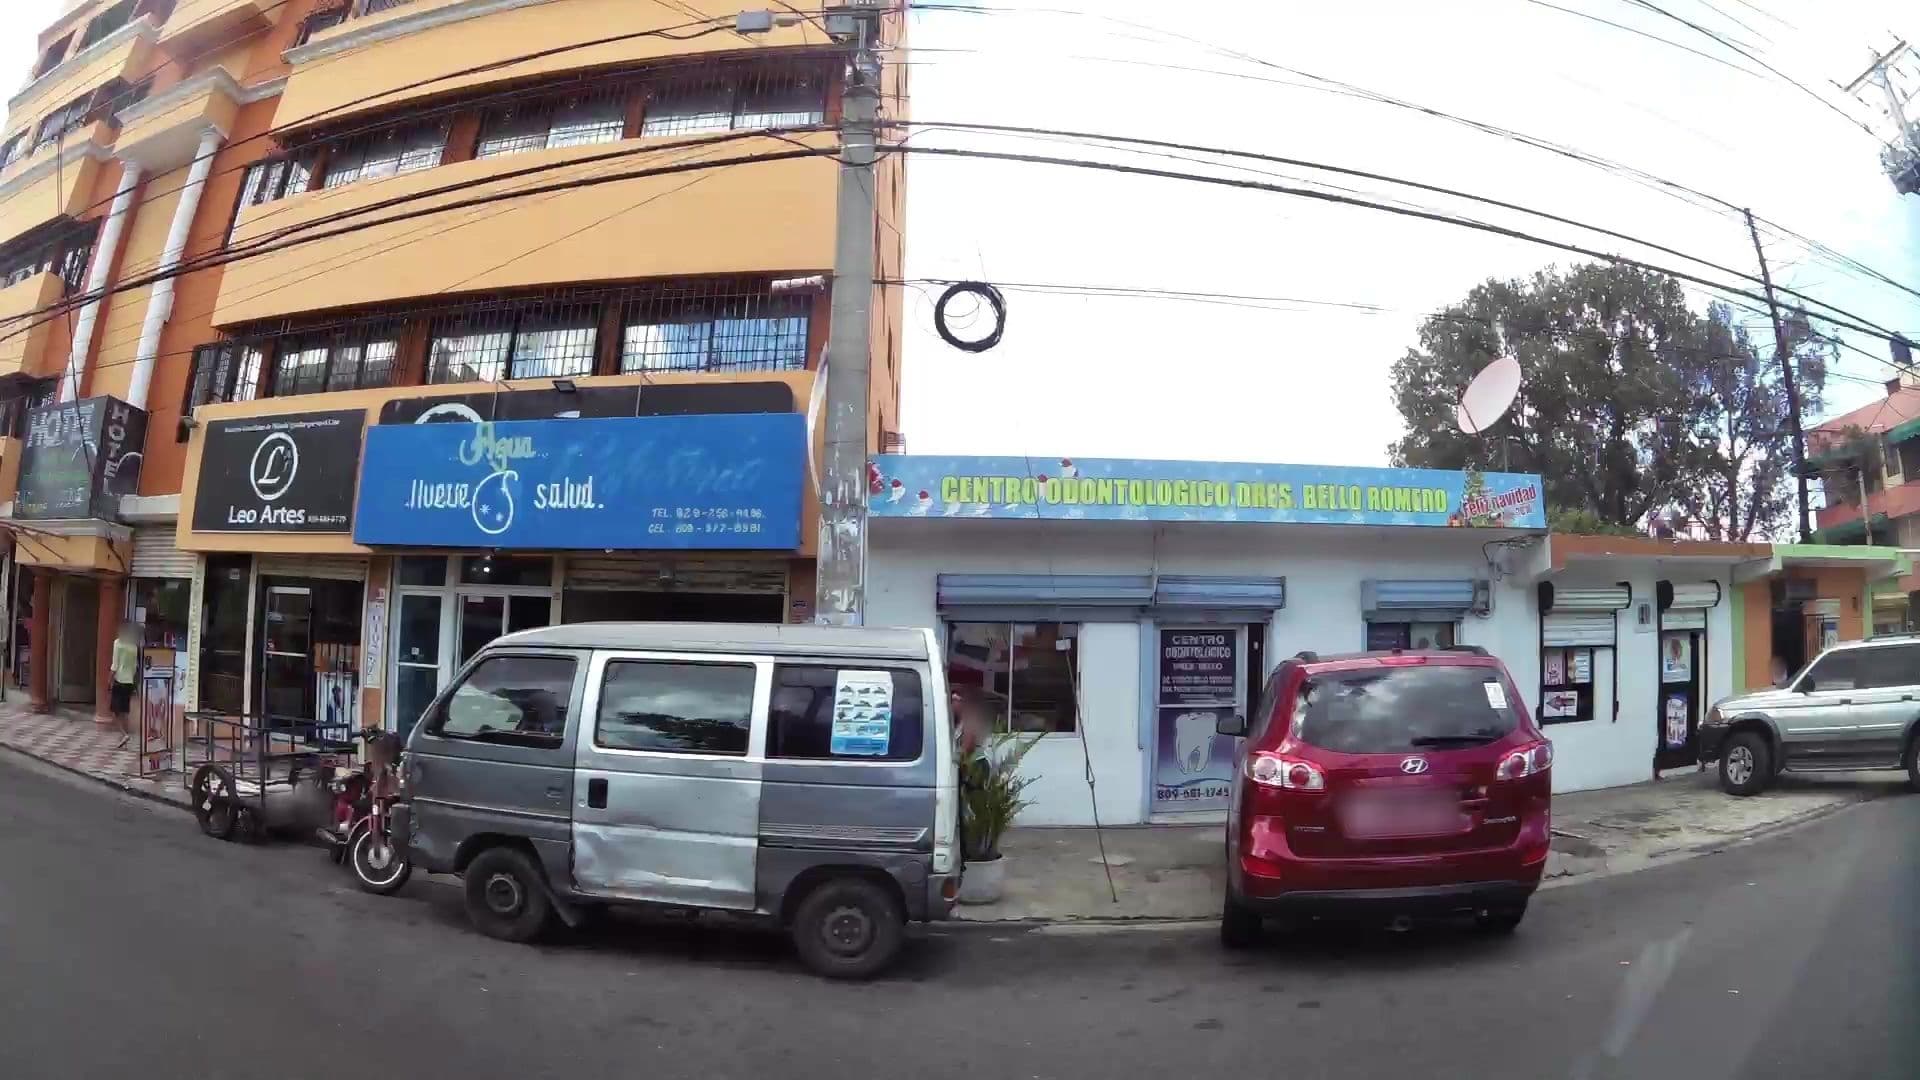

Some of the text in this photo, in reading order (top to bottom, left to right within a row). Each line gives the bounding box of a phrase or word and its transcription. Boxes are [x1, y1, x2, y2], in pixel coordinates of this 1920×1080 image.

[103, 405, 130, 496] HOTEL
[942, 476, 1038, 504] CENTRO
[1046, 478, 1231, 507] ODONTOLOGICO
[1303, 485, 1361, 511] BELLO
[1367, 487, 1448, 513] ROMERO
[228, 505, 257, 524] Leo
[260, 505, 306, 524] Artes
